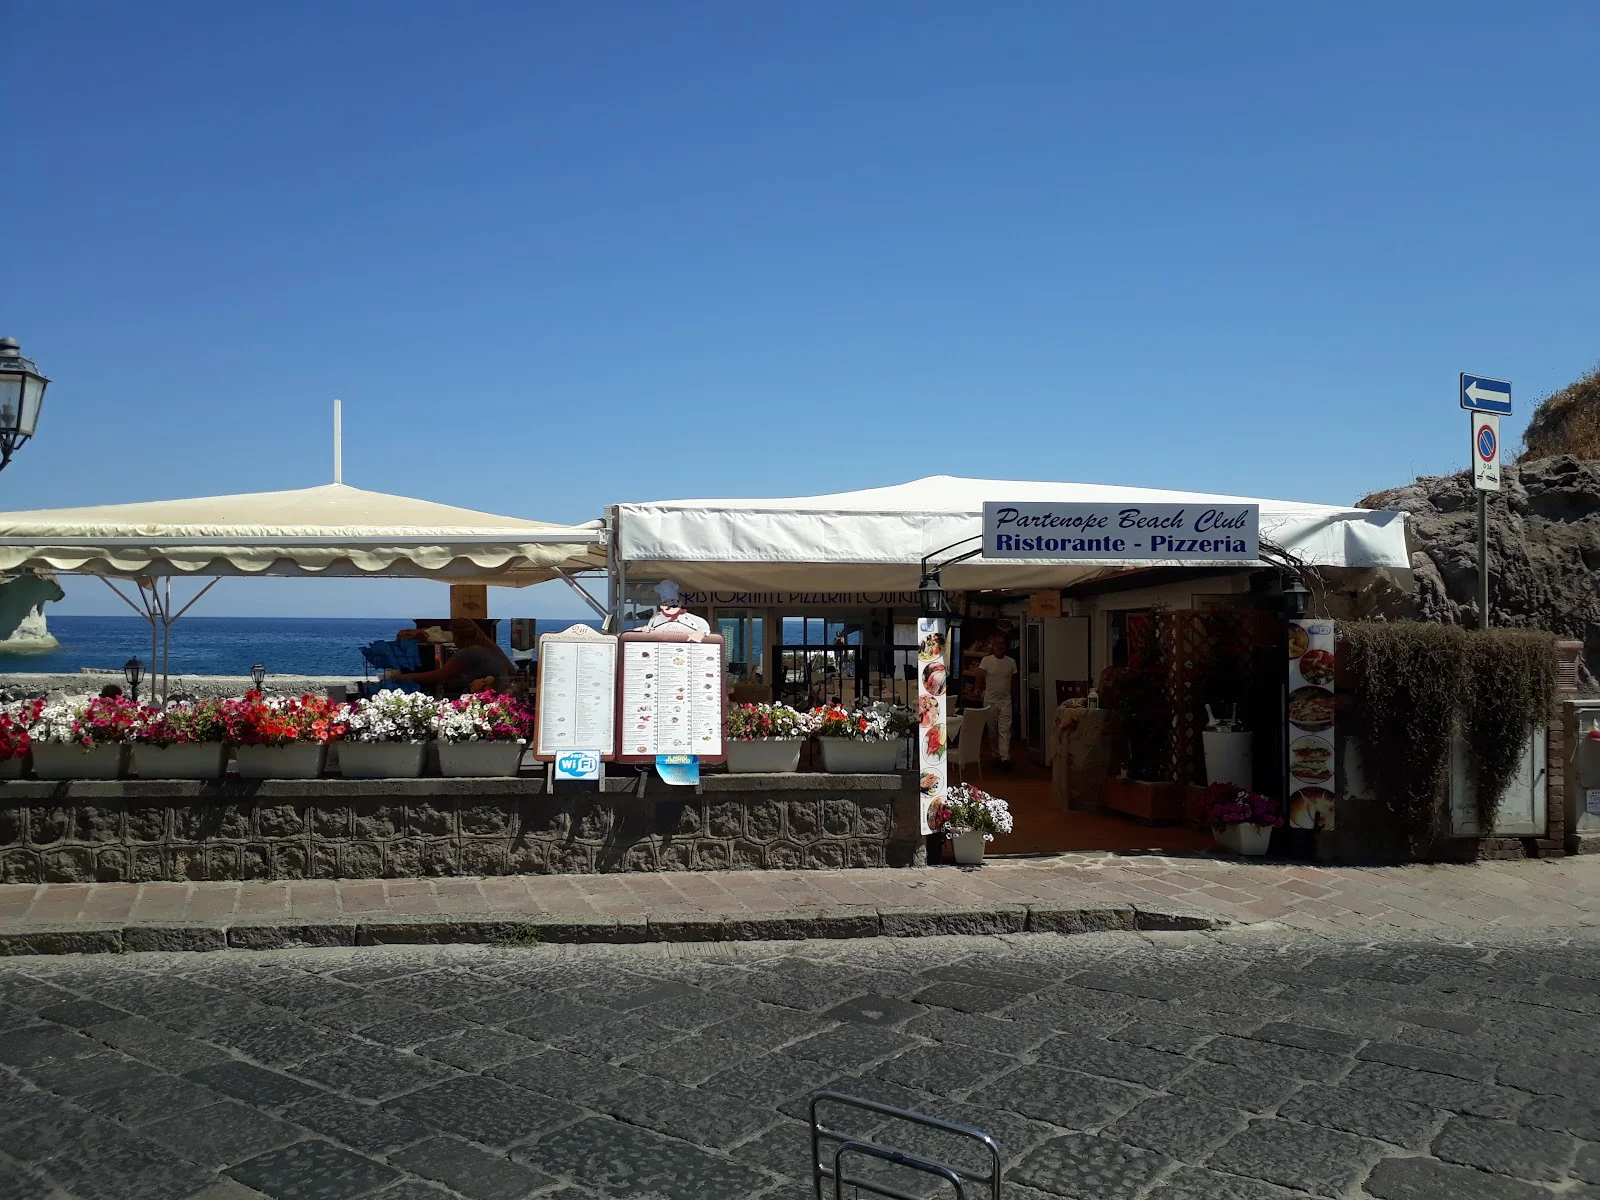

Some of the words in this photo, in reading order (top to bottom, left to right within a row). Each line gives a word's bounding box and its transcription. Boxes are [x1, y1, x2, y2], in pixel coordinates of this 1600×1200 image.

[997, 507, 1108, 533] Partenope
[1118, 508, 1185, 529] Beach
[1194, 509, 1249, 533] Club
[996, 534, 1126, 552] Ristorante
[1150, 535, 1247, 552] Pizzeria
